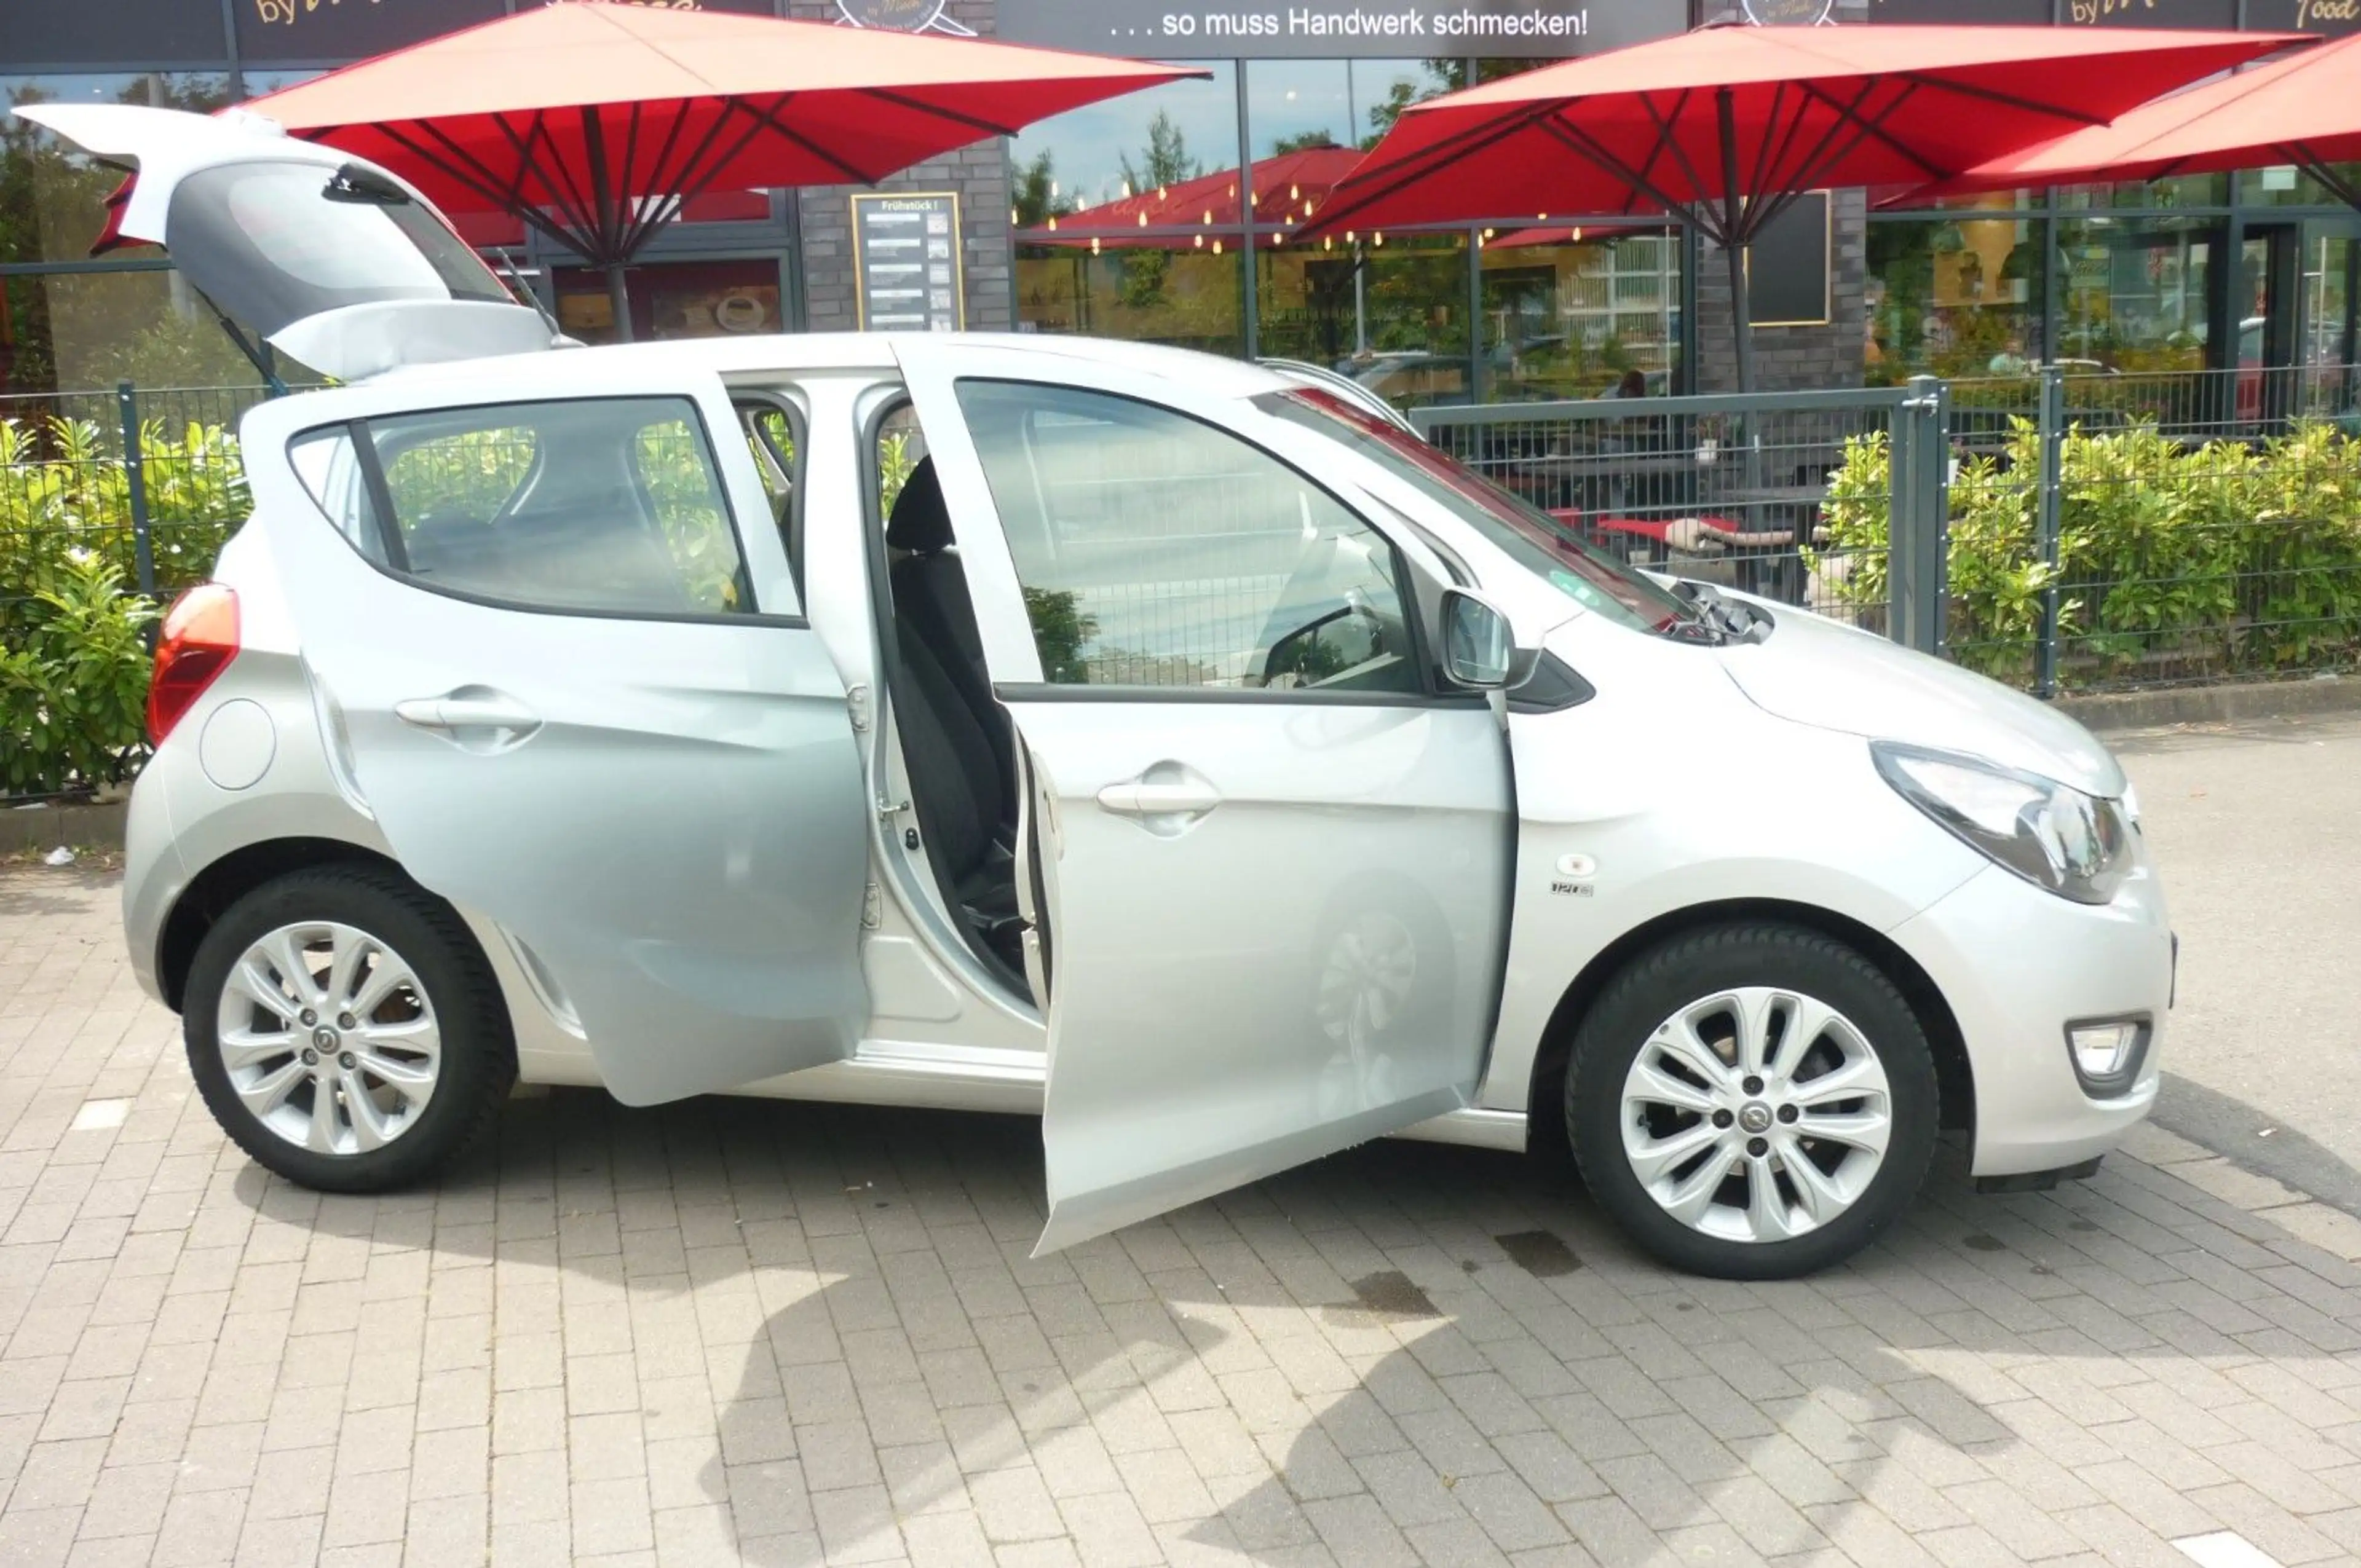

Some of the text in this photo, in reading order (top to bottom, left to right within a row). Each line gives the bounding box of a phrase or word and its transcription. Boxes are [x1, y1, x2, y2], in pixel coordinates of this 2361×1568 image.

[256, 0, 295, 24] by
[1163, 14, 1195, 36] so
[1205, 14, 1279, 36] muss
[1289, 8, 1425, 36] Handwerk
[1433, 8, 1588, 36] schmecken!
[2071, 0, 2098, 24] by
